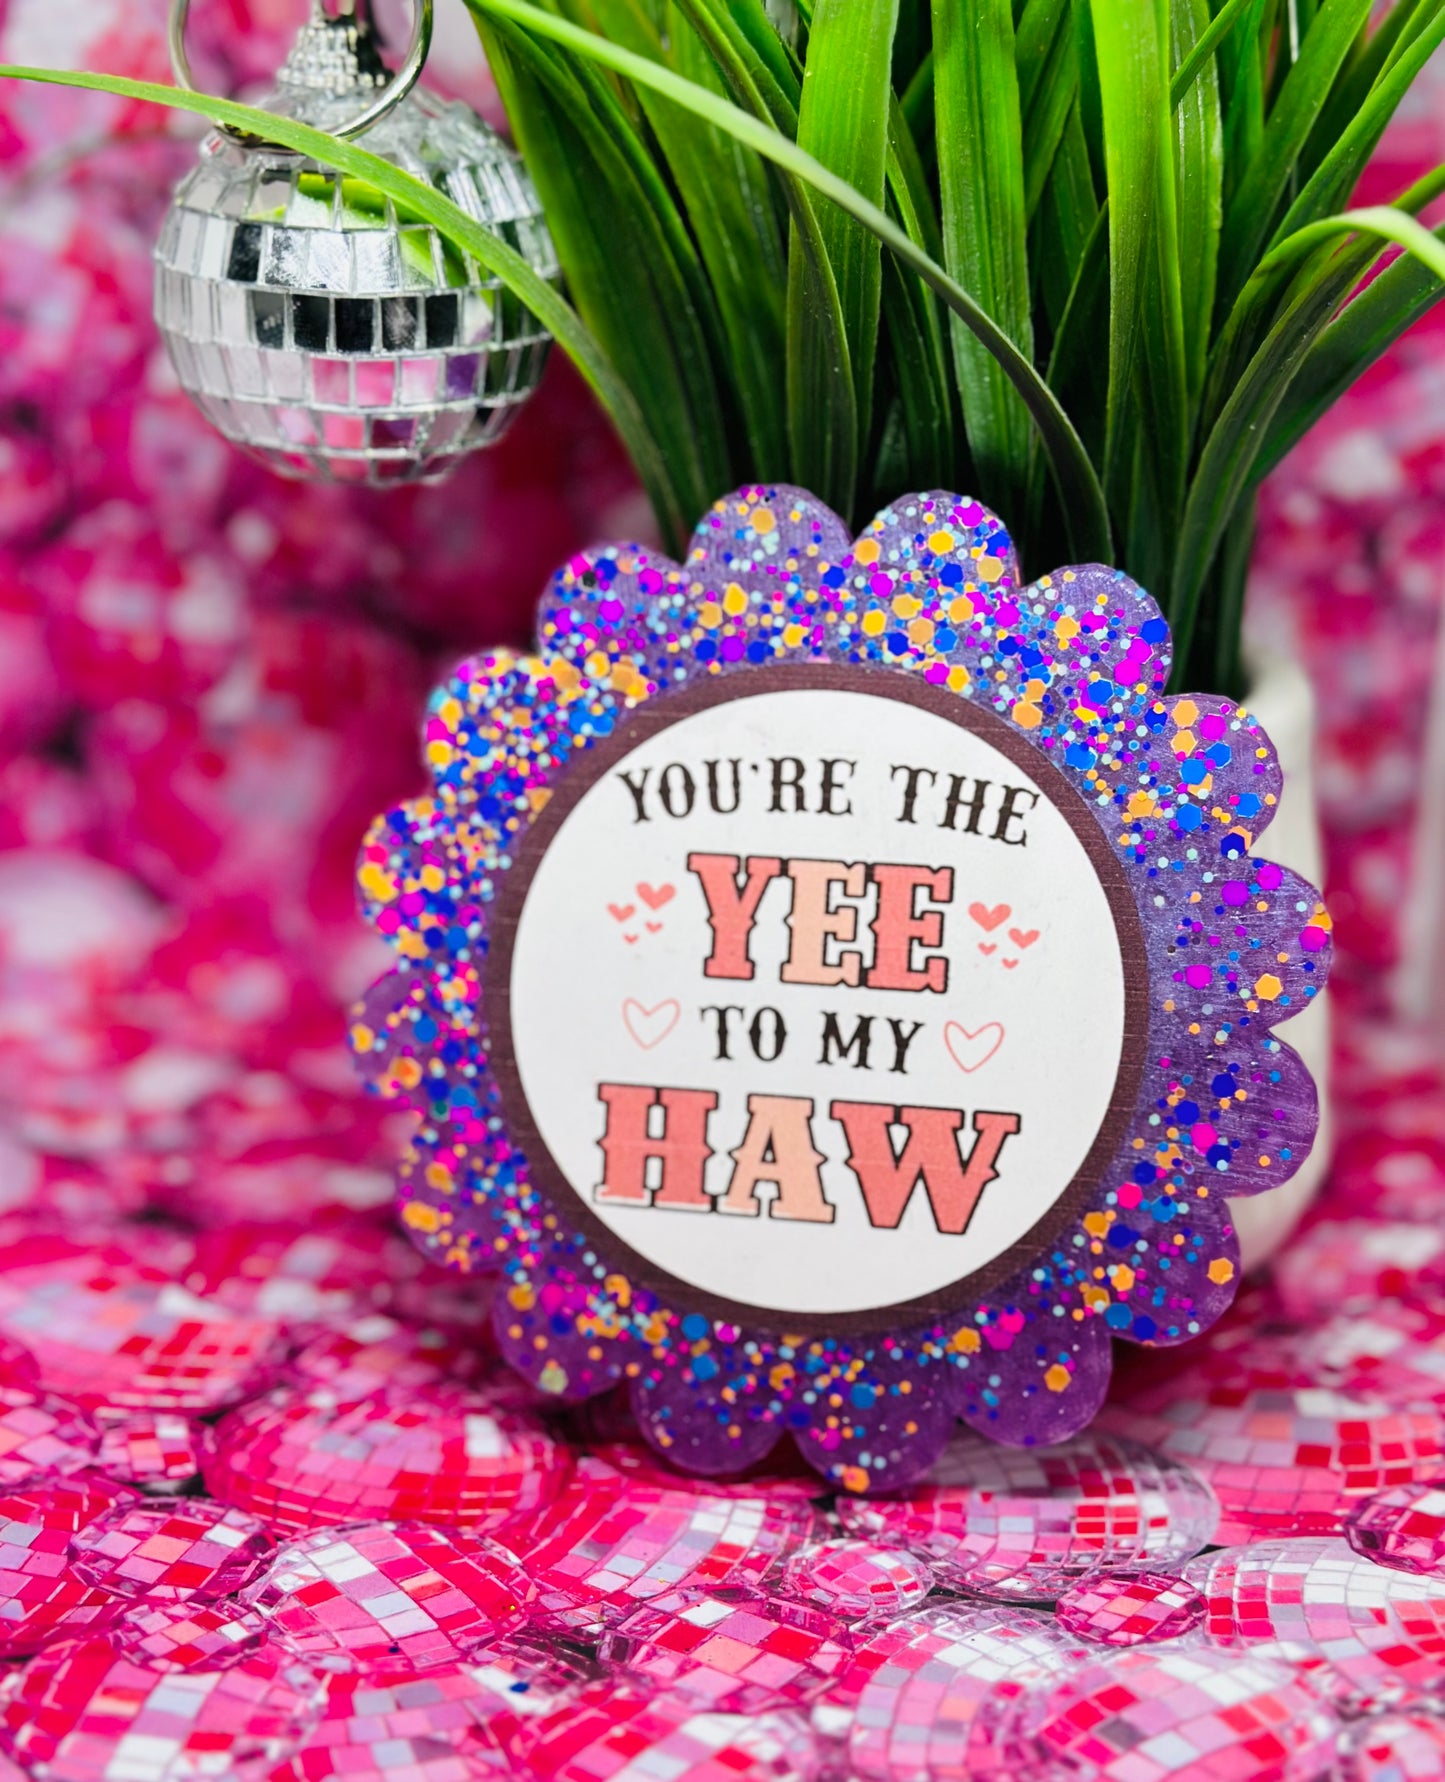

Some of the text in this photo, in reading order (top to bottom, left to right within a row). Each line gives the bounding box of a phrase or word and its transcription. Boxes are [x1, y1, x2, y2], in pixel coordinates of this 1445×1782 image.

[617, 757, 1040, 847] YOU'RE THE
[686, 852, 955, 994] YEE
[700, 1006, 924, 1074] TO MY
[594, 1082, 1021, 1236] HAW
